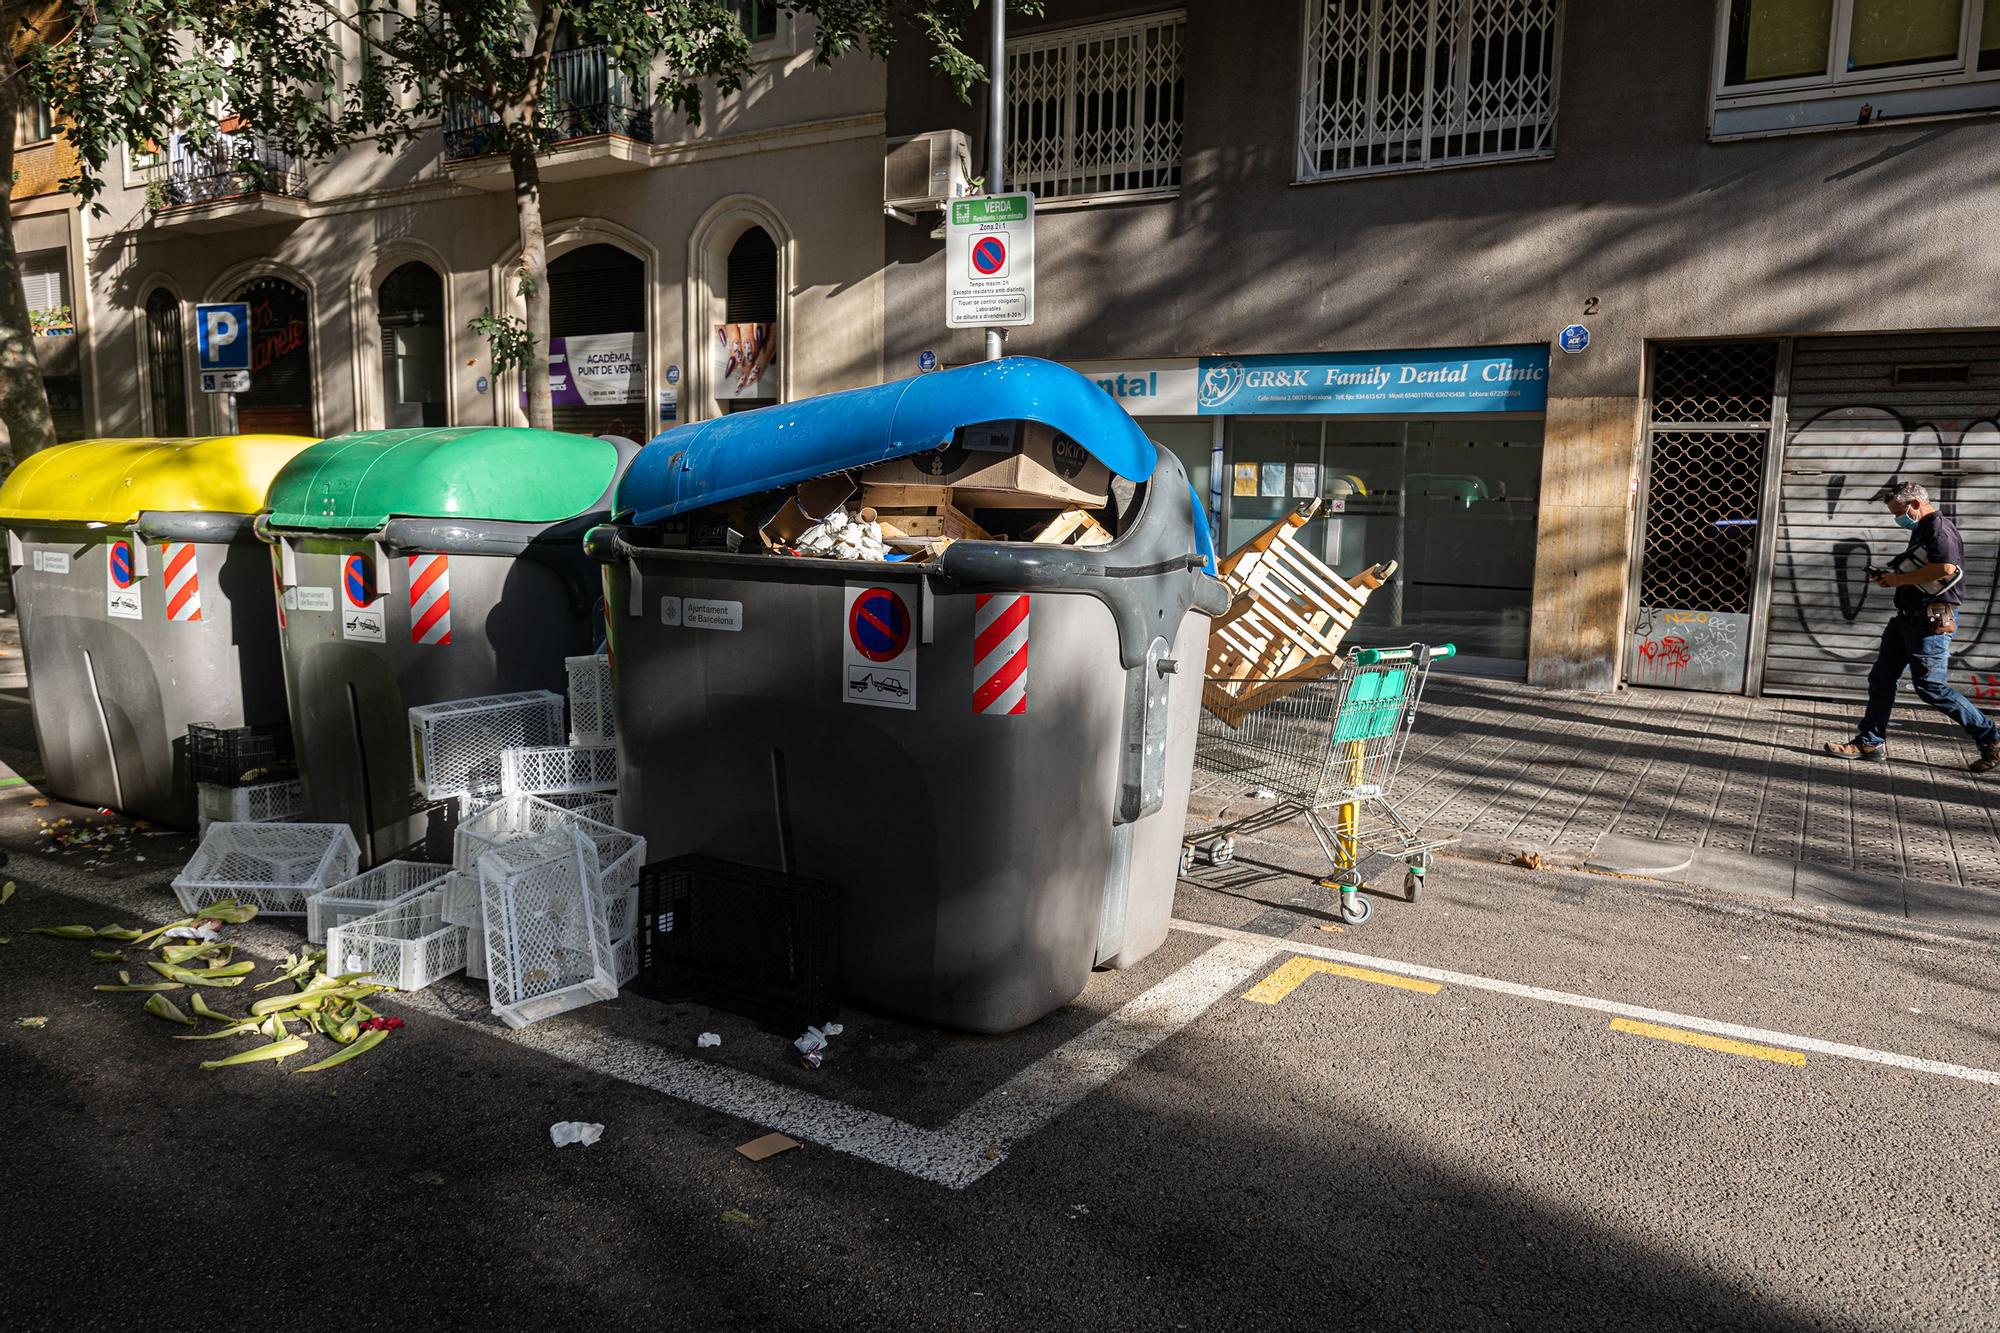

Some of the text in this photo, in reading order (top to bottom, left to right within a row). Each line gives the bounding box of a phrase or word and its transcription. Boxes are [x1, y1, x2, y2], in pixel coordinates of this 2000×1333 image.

[985, 200, 1011, 213] VERDA
[1583, 296, 1600, 315] 2
[207, 311, 238, 362] P
[587, 351, 631, 364] ACADÈMIA
[578, 363, 642, 376] PUNT DE VENTA
[1246, 361, 1544, 391] GR&K Family Dental Clinic
[1097, 371, 1157, 398] ntal
[688, 603, 728, 615] Ajuntament
[688, 614, 733, 625] de Barcelona
